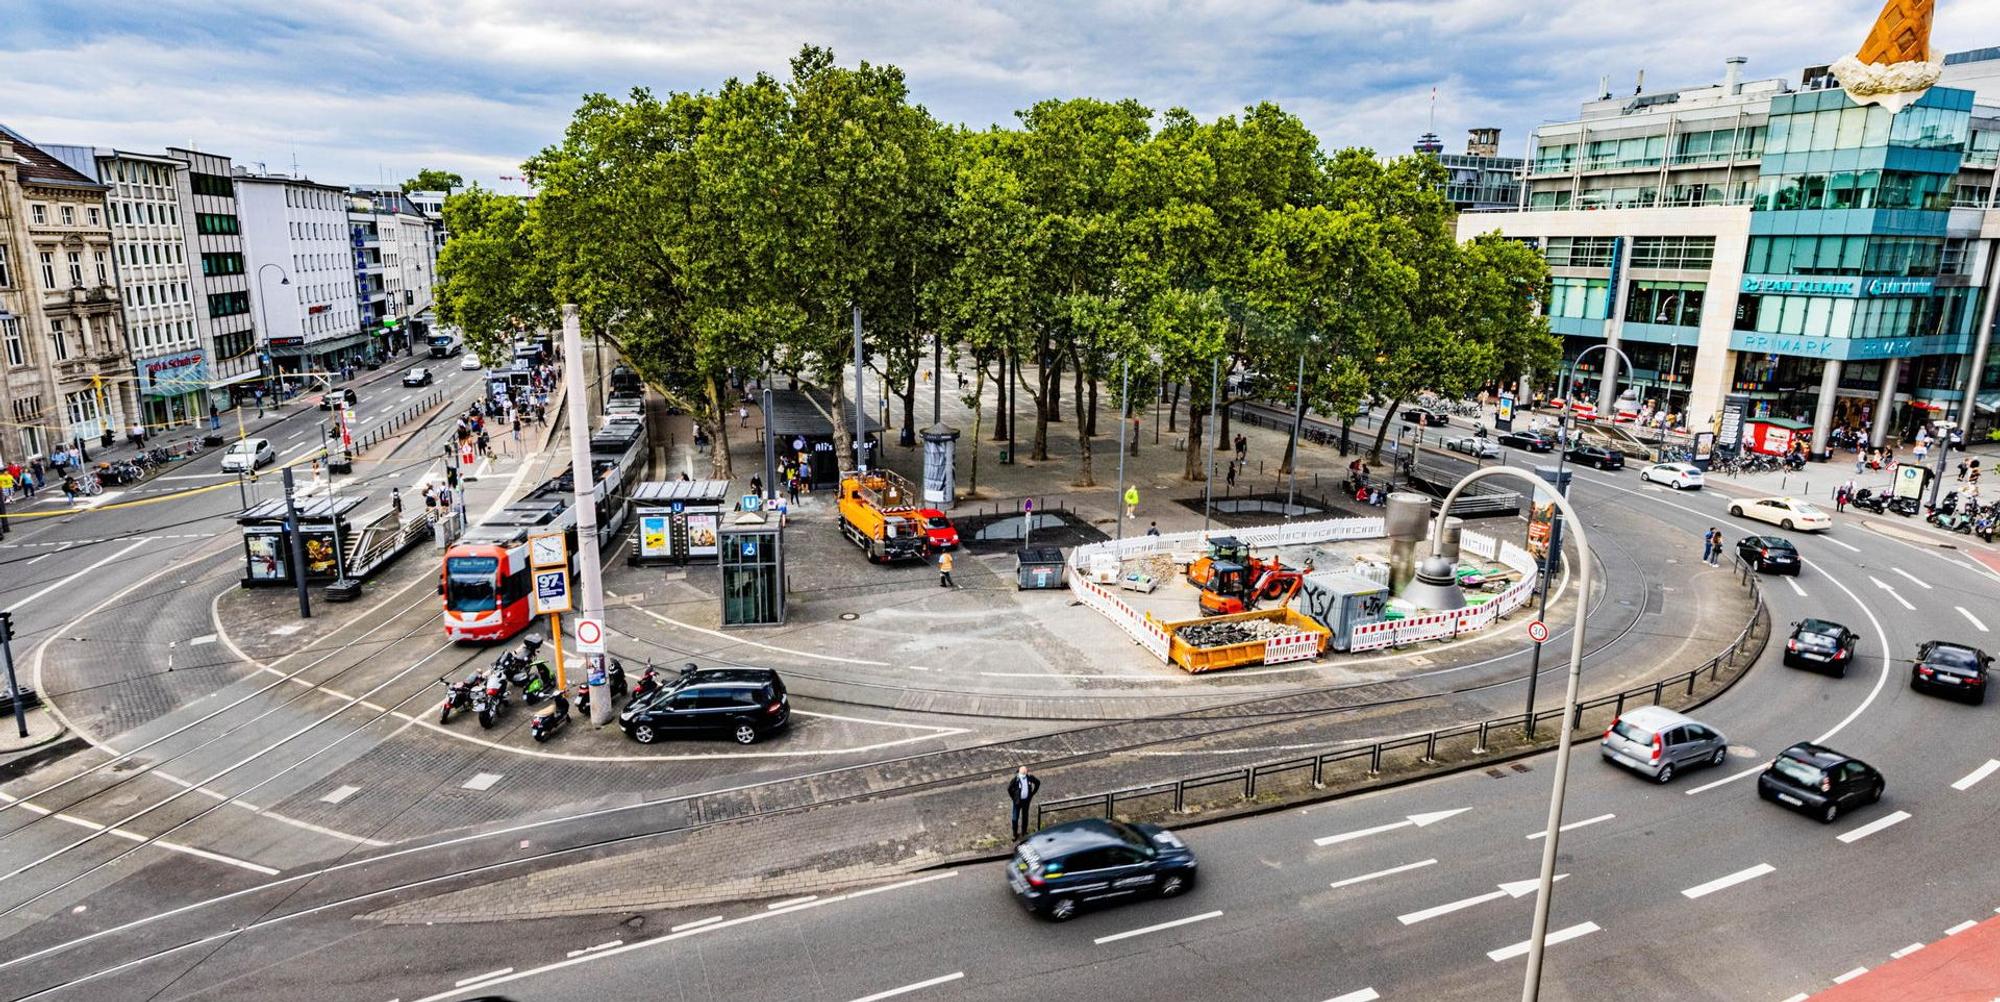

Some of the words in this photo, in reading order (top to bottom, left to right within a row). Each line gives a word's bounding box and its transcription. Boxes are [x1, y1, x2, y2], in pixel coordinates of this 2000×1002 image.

[1764, 280, 1794, 292] PAN
[1798, 281, 1854, 295] KLINIK
[1745, 336, 1832, 354] PRIMARK
[815, 442, 833, 452] Ali's
[674, 502, 682, 511] U
[745, 496, 755, 507] U
[538, 574, 559, 588] 97
[1533, 626, 1544, 637] 30
